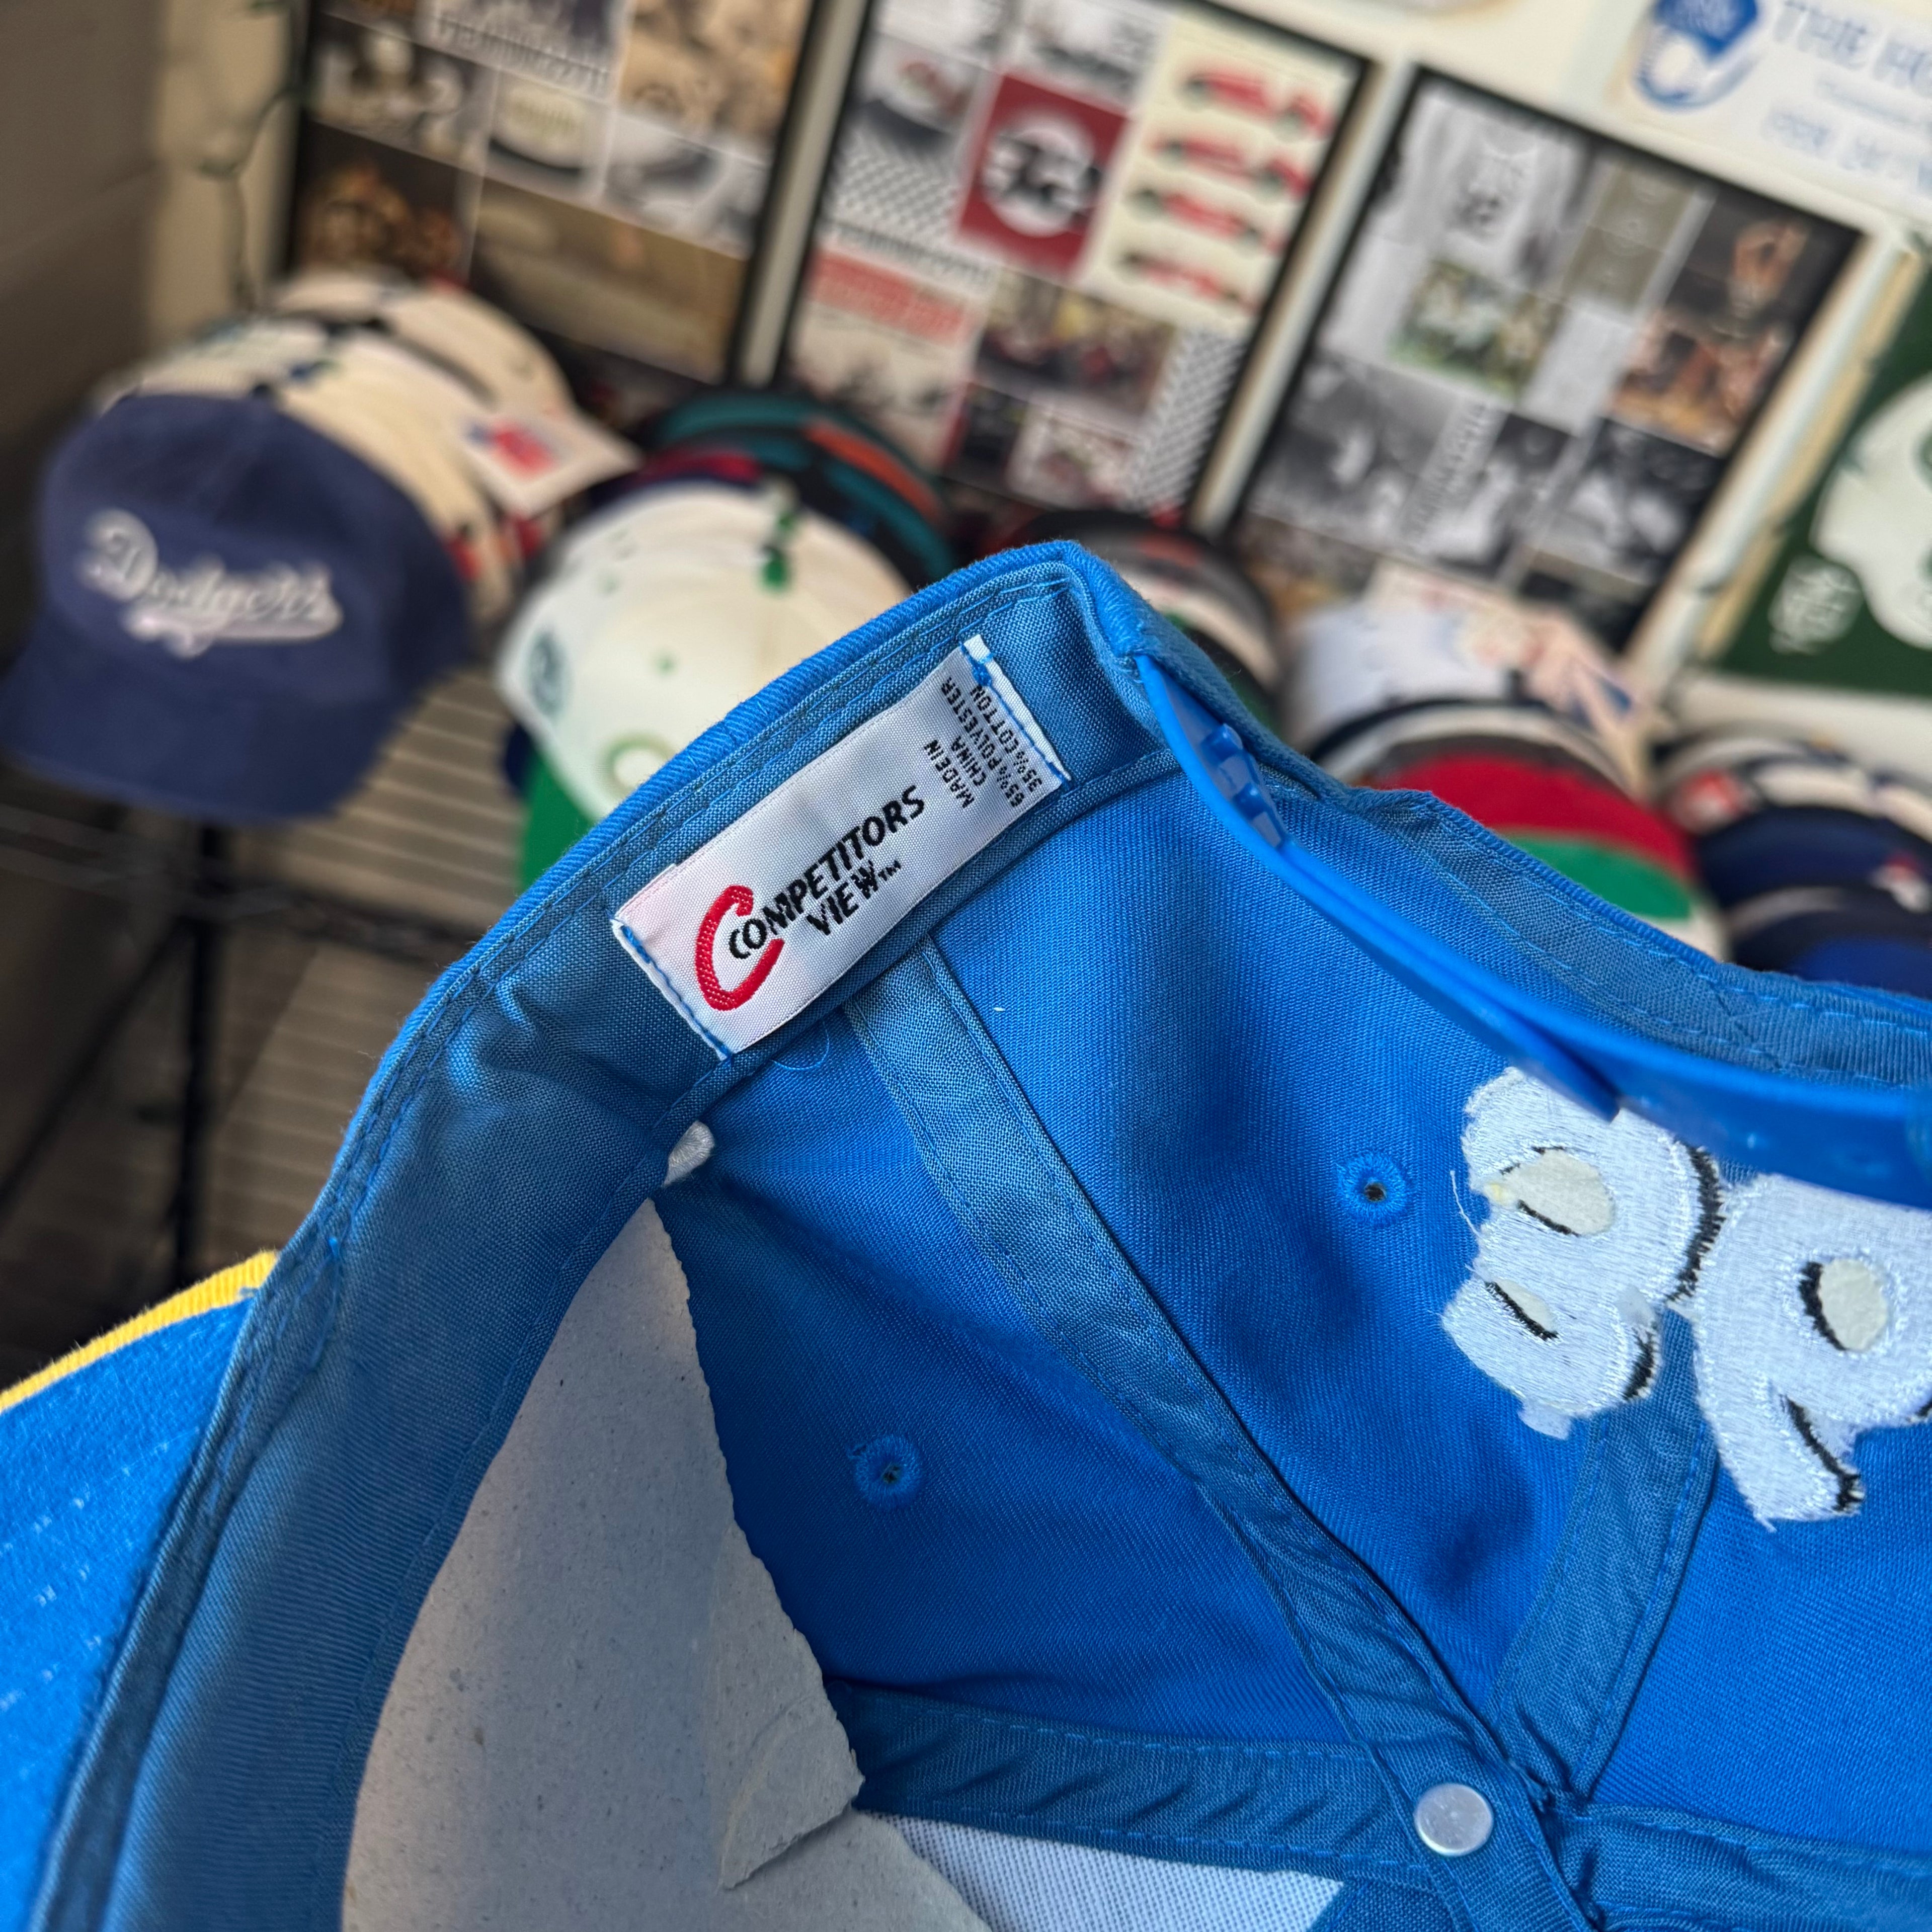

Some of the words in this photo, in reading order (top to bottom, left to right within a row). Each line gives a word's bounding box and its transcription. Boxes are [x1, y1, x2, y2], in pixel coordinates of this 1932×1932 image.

[941, 677, 1003, 771] POLYESTER
[970, 684, 1019, 754] COTTON
[924, 739, 944, 761] IN
[951, 735, 987, 786] CHINA
[1013, 750, 1043, 792] 35%
[934, 756, 975, 809] MADE
[997, 765, 1025, 808] 65%
[728, 784, 926, 960] COMPETITORS
